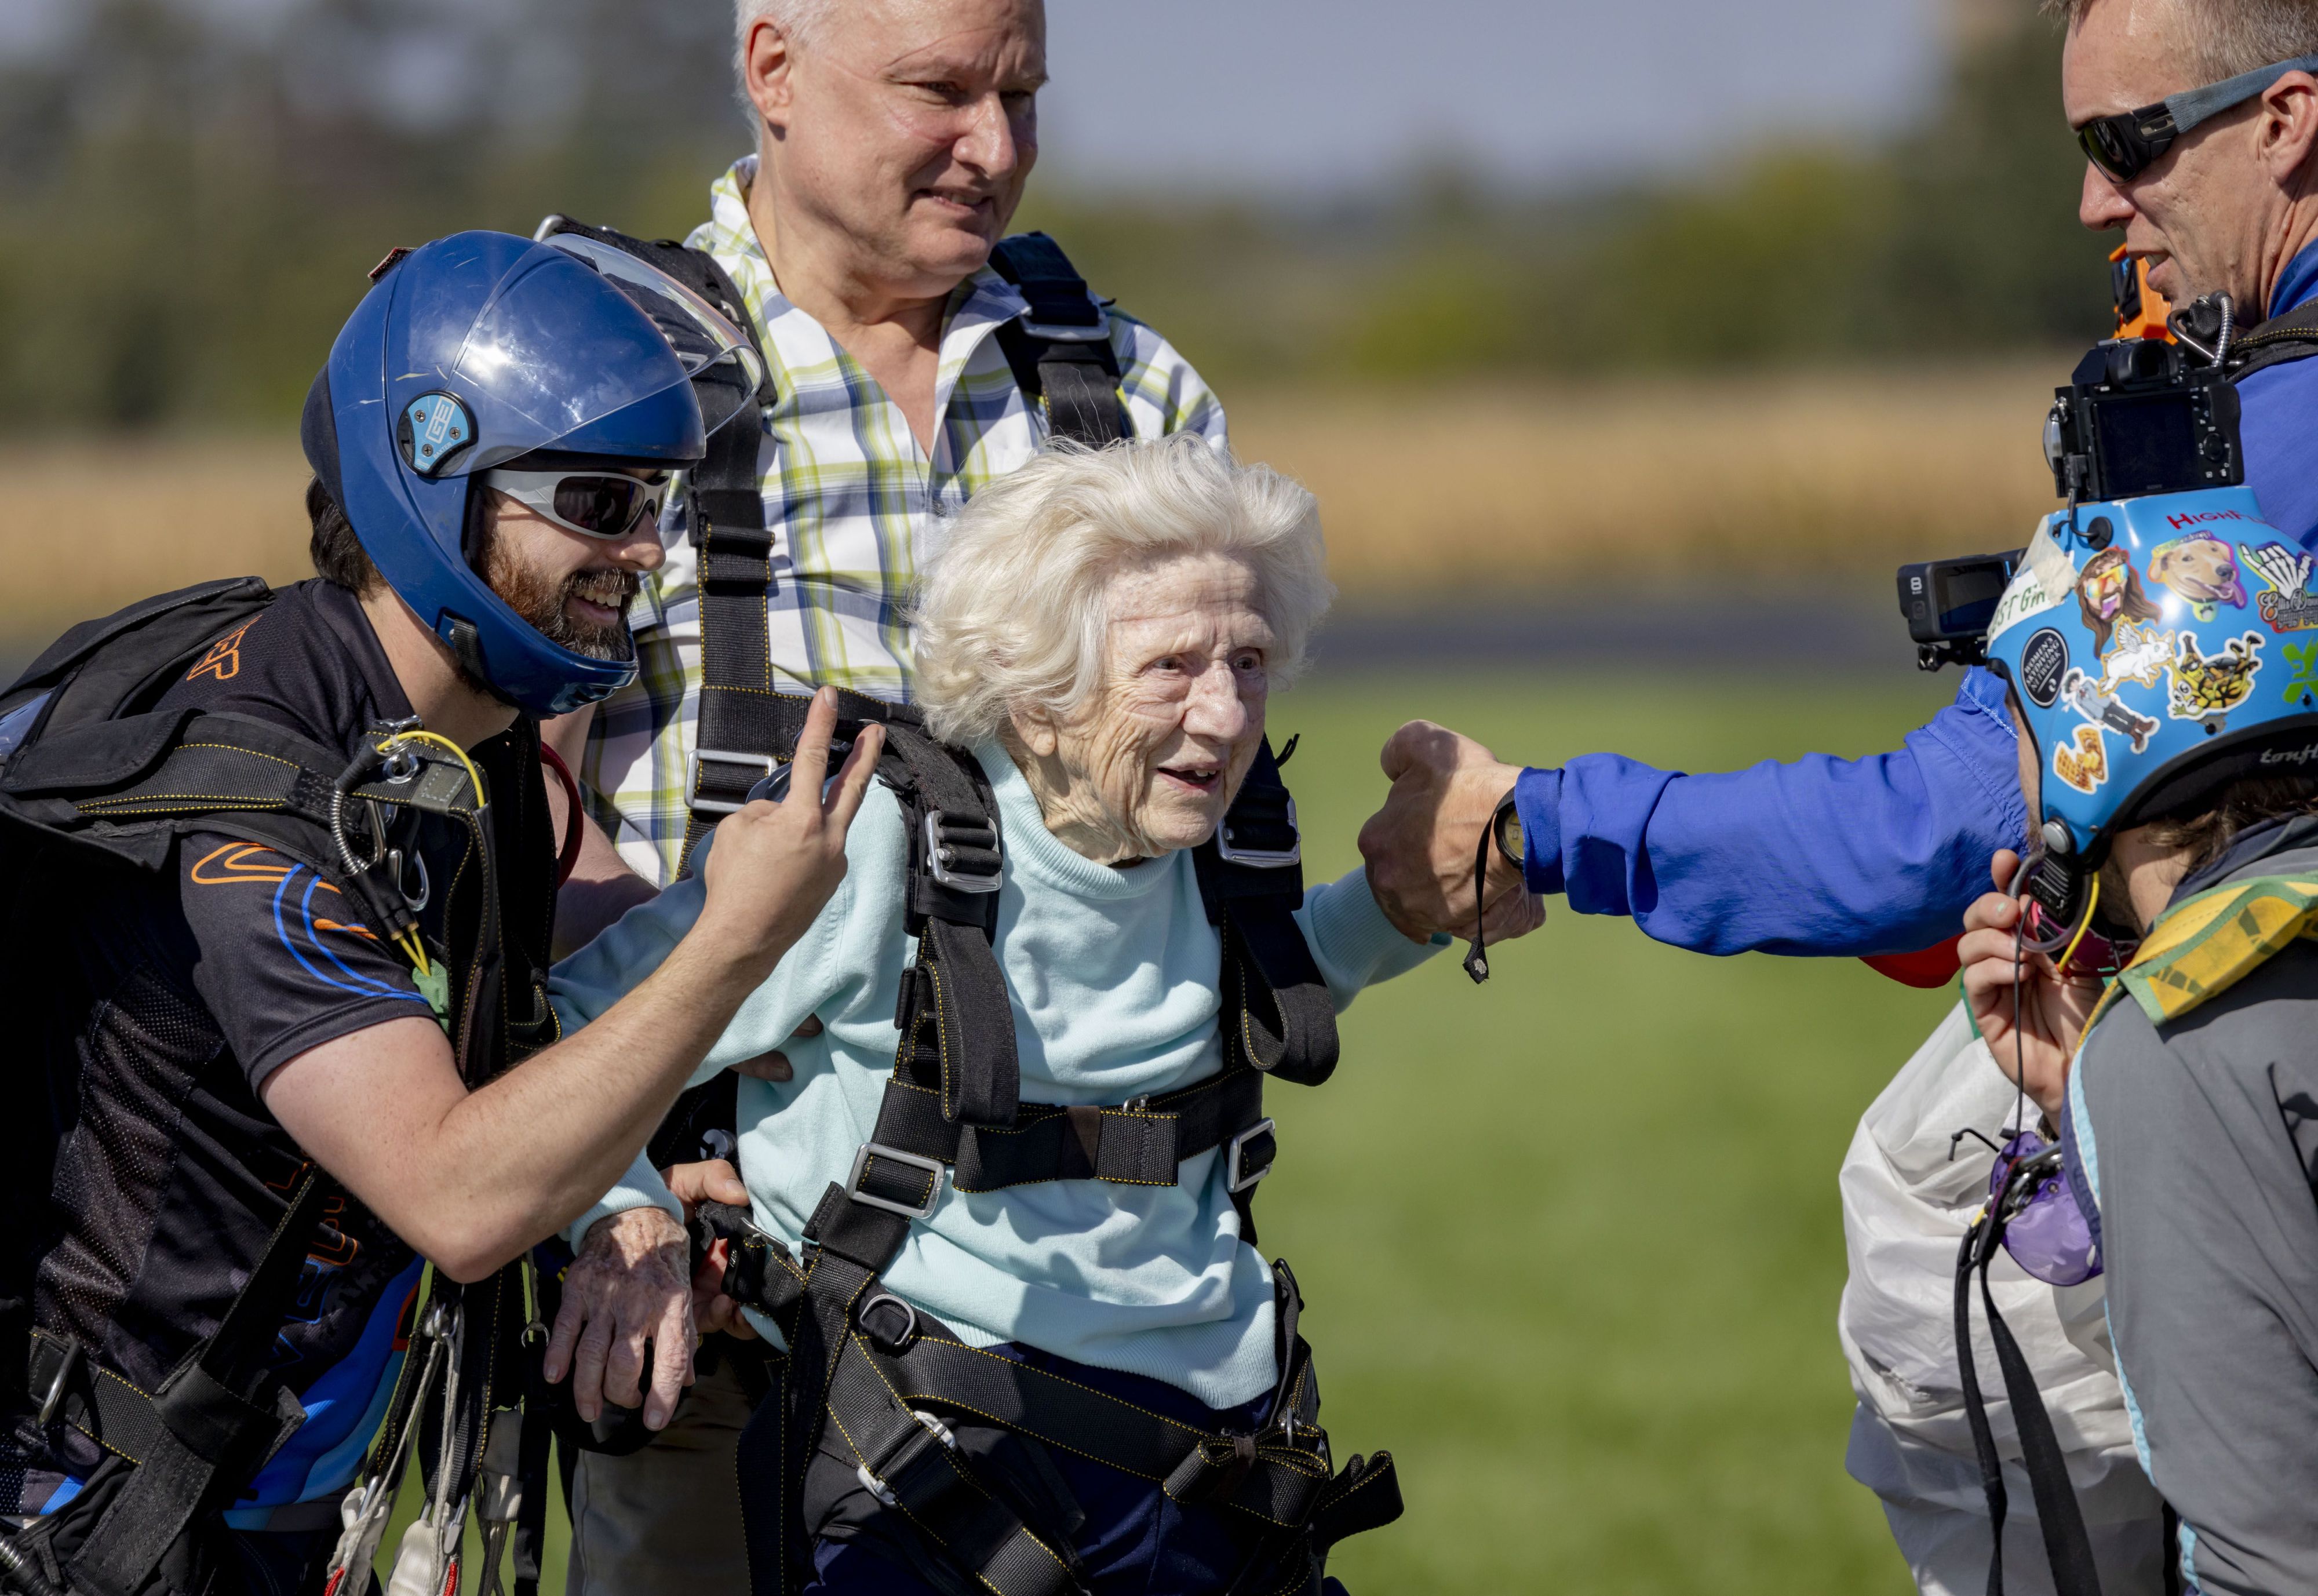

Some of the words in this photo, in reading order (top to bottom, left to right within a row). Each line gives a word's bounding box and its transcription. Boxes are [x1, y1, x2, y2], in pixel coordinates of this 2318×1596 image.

[433, 442, 453, 459] BAXTER
[1911, 577, 1923, 591] 8
[2026, 639, 2060, 687] SKYDIVING
[2031, 648, 2061, 692] NETWORK
